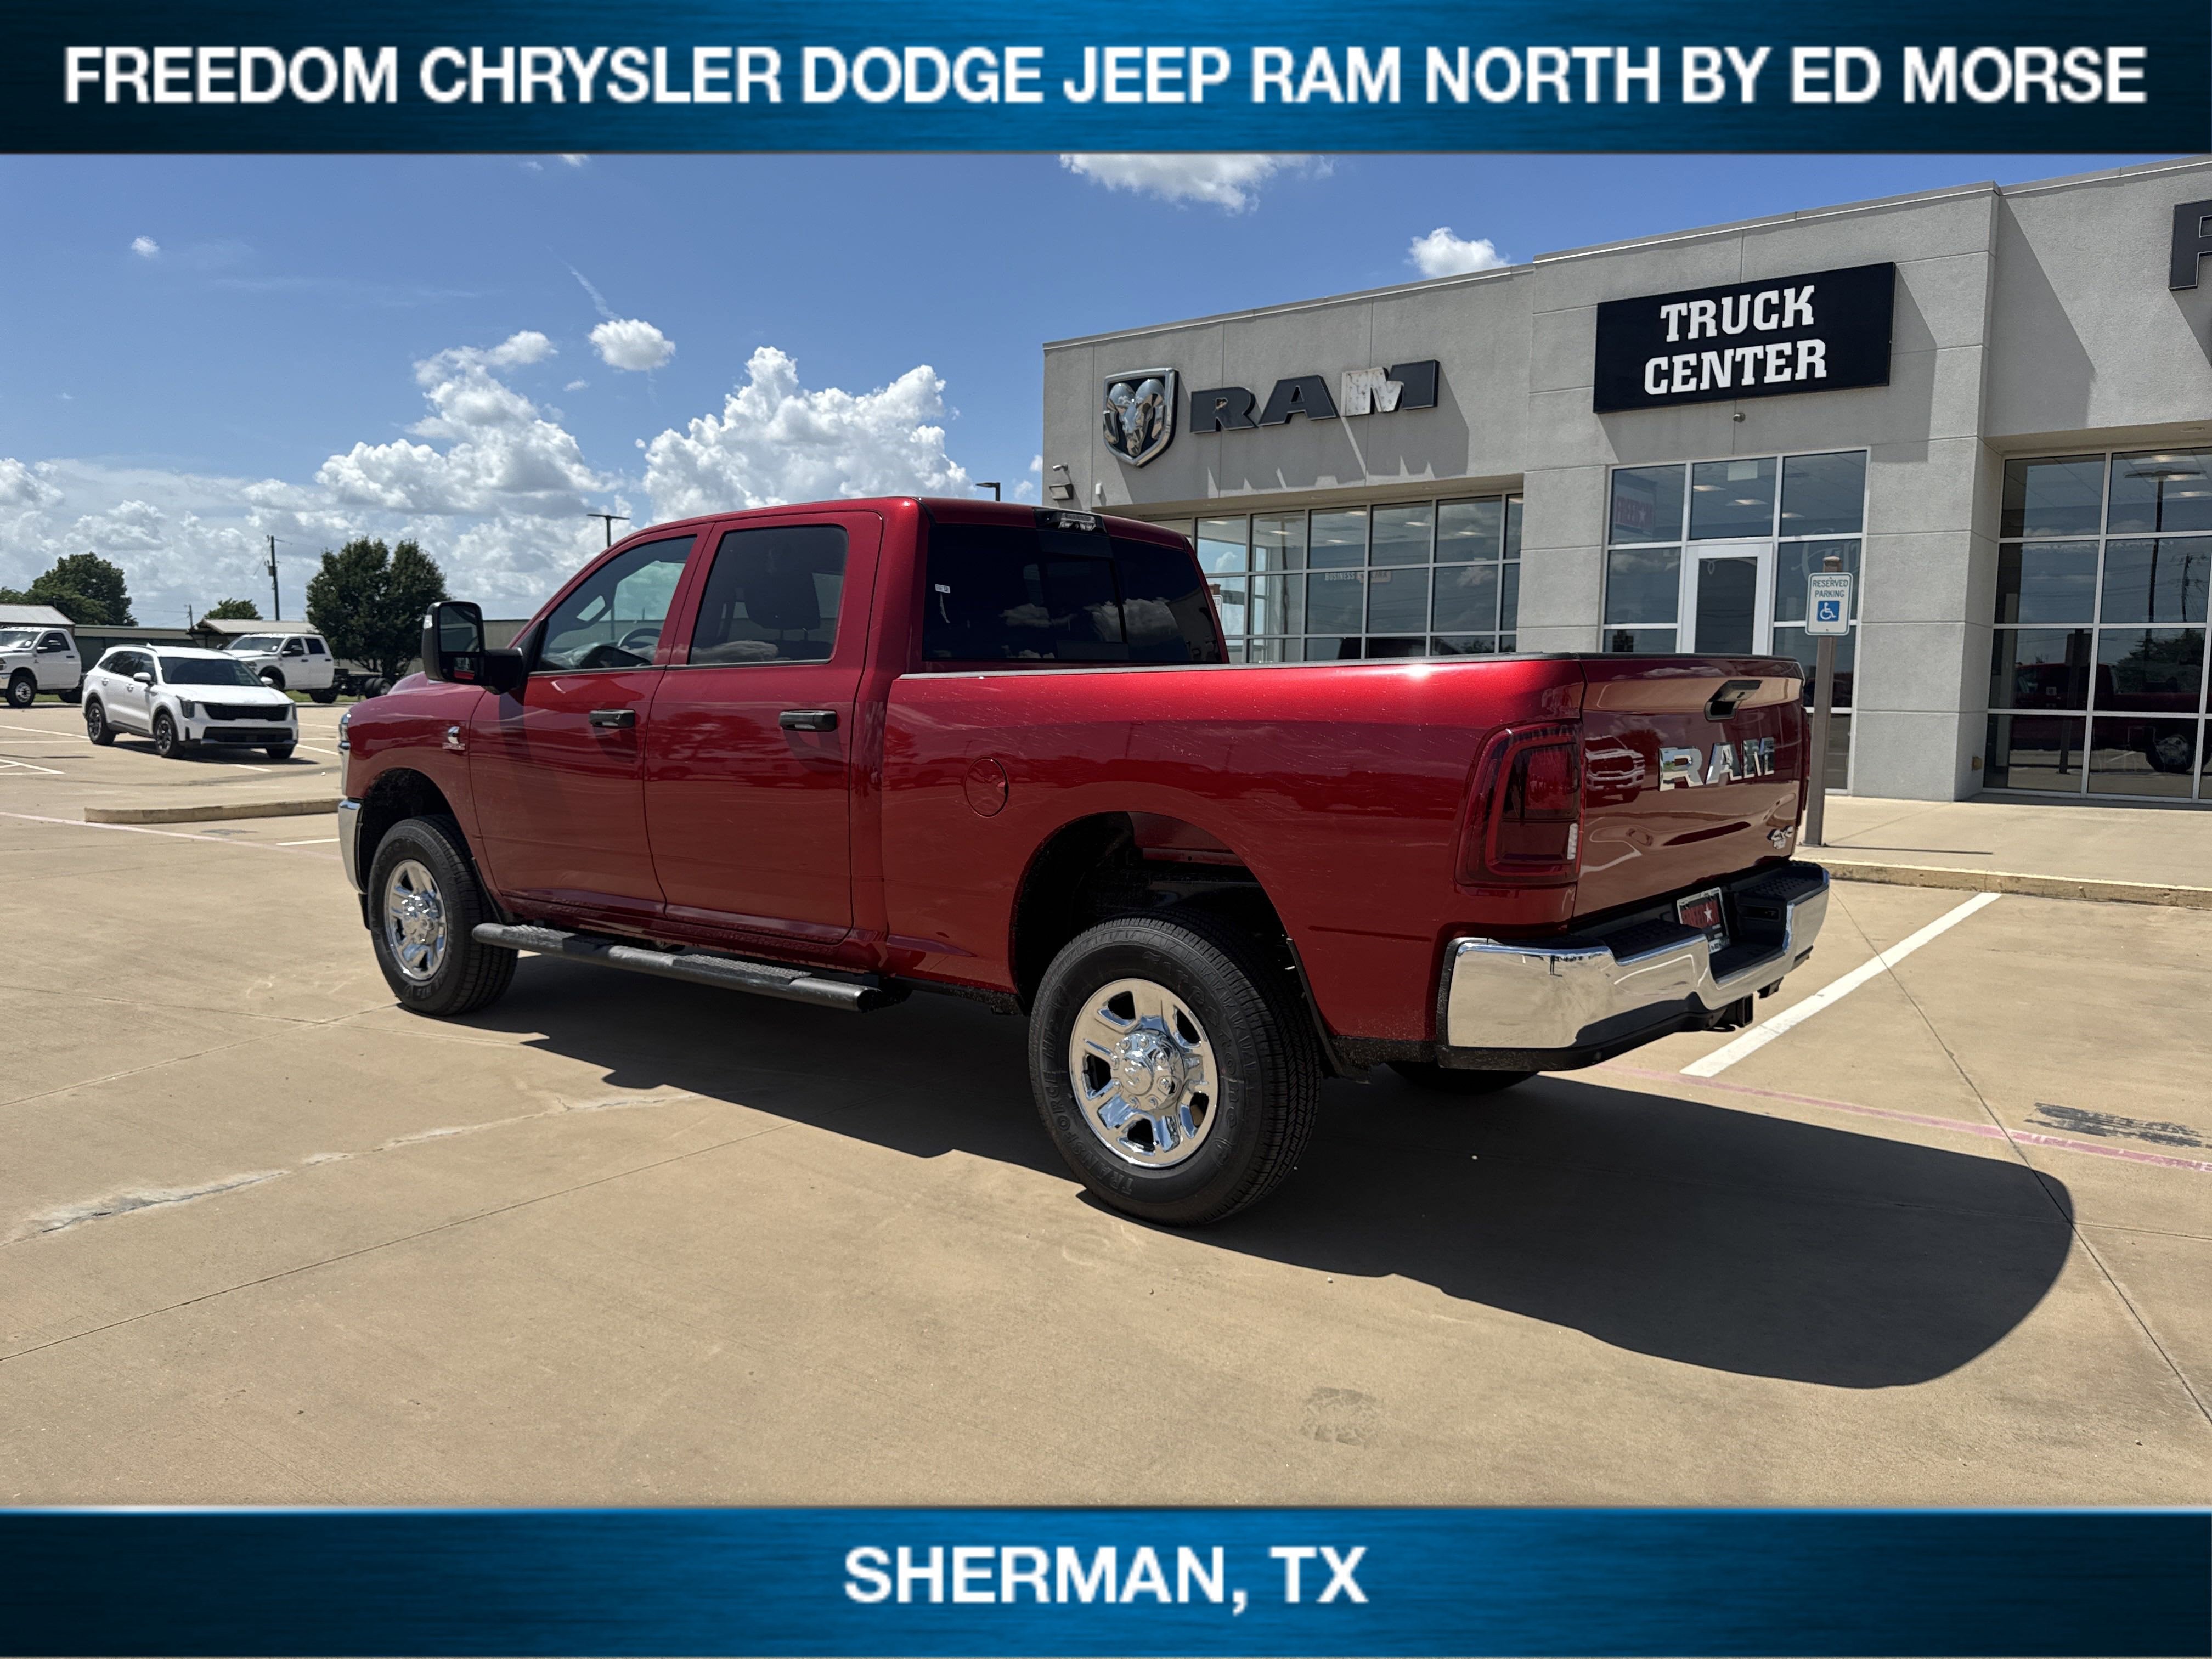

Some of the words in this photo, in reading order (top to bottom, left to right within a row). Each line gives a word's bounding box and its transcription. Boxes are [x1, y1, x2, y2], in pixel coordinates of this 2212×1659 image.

[1660, 284, 1815, 343] TRUCK
[1190, 359, 1440, 433] RAM
[1644, 338, 1828, 396] CENTER
[1324, 572, 1355, 582] BUSINESS
[1812, 579, 1848, 588] RESERVED
[1658, 736, 1775, 792] RAM
[1046, 1070, 1135, 1195] TRANSFORCE
